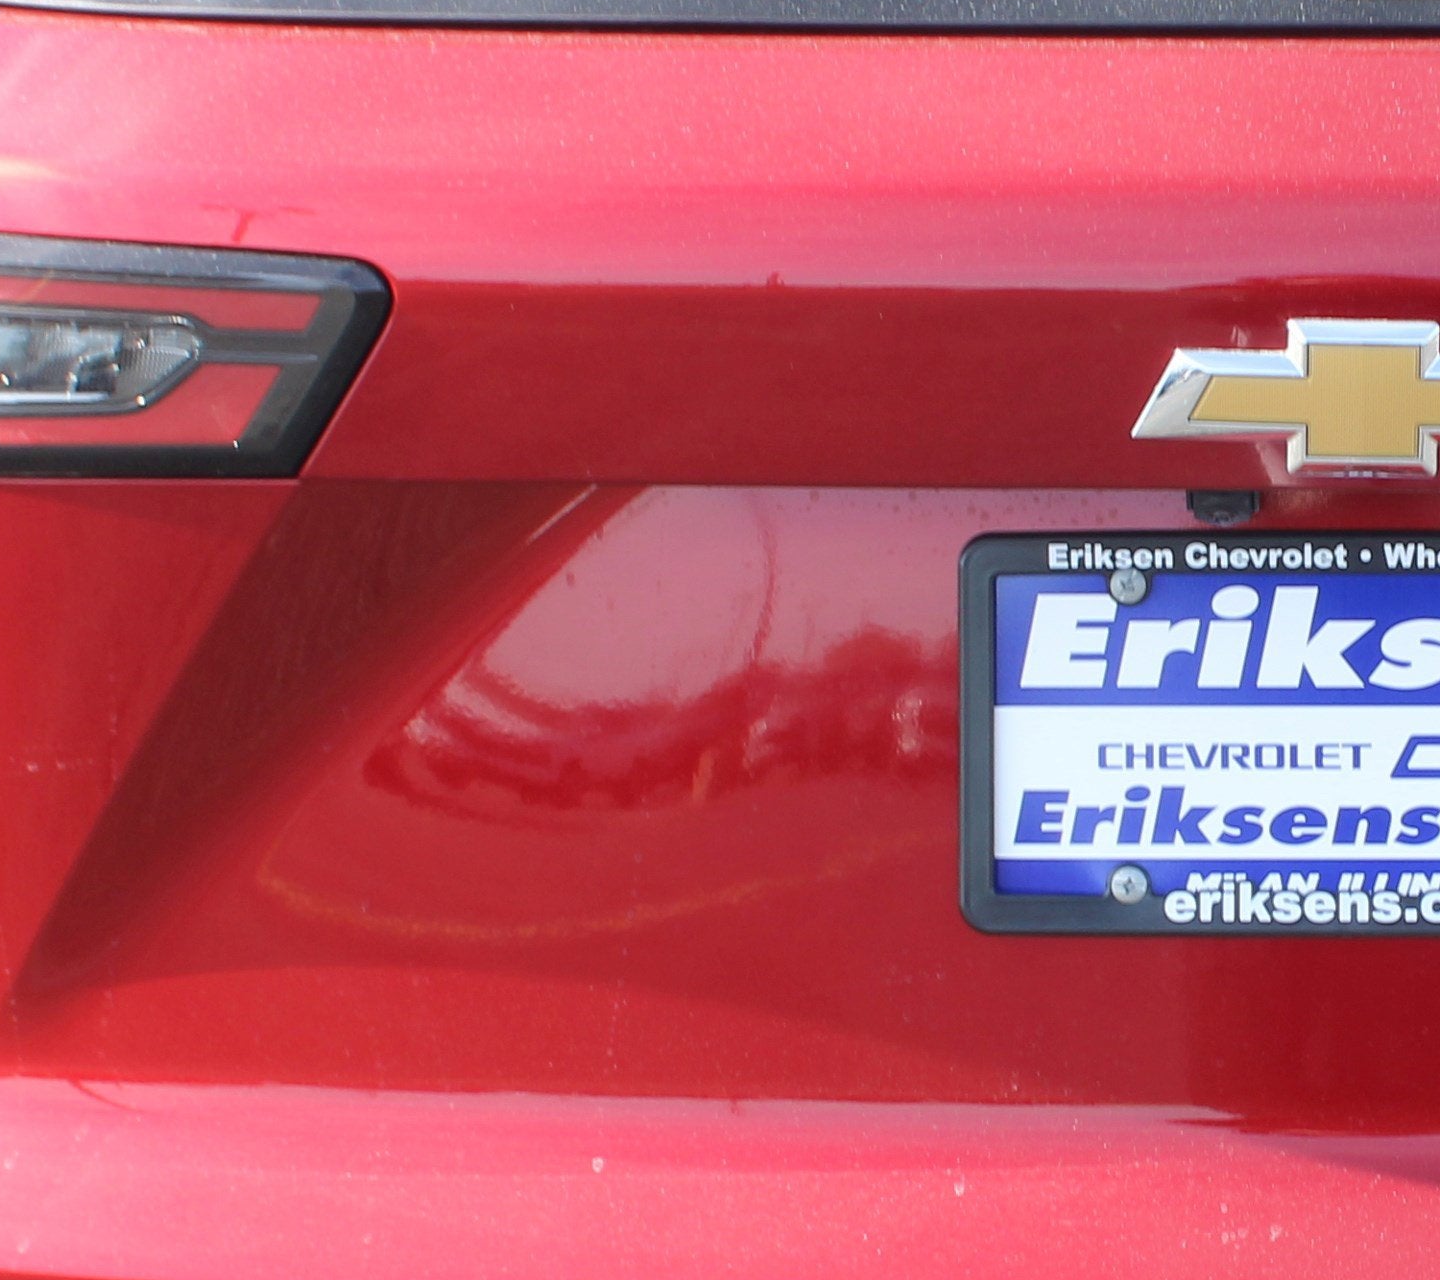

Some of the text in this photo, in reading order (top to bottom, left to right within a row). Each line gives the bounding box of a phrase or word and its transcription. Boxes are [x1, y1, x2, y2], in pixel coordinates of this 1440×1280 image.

[1047, 542, 1174, 570] Eriksen
[1184, 541, 1349, 570] Chevrolet
[1097, 742, 1372, 770] CHEVROLET
